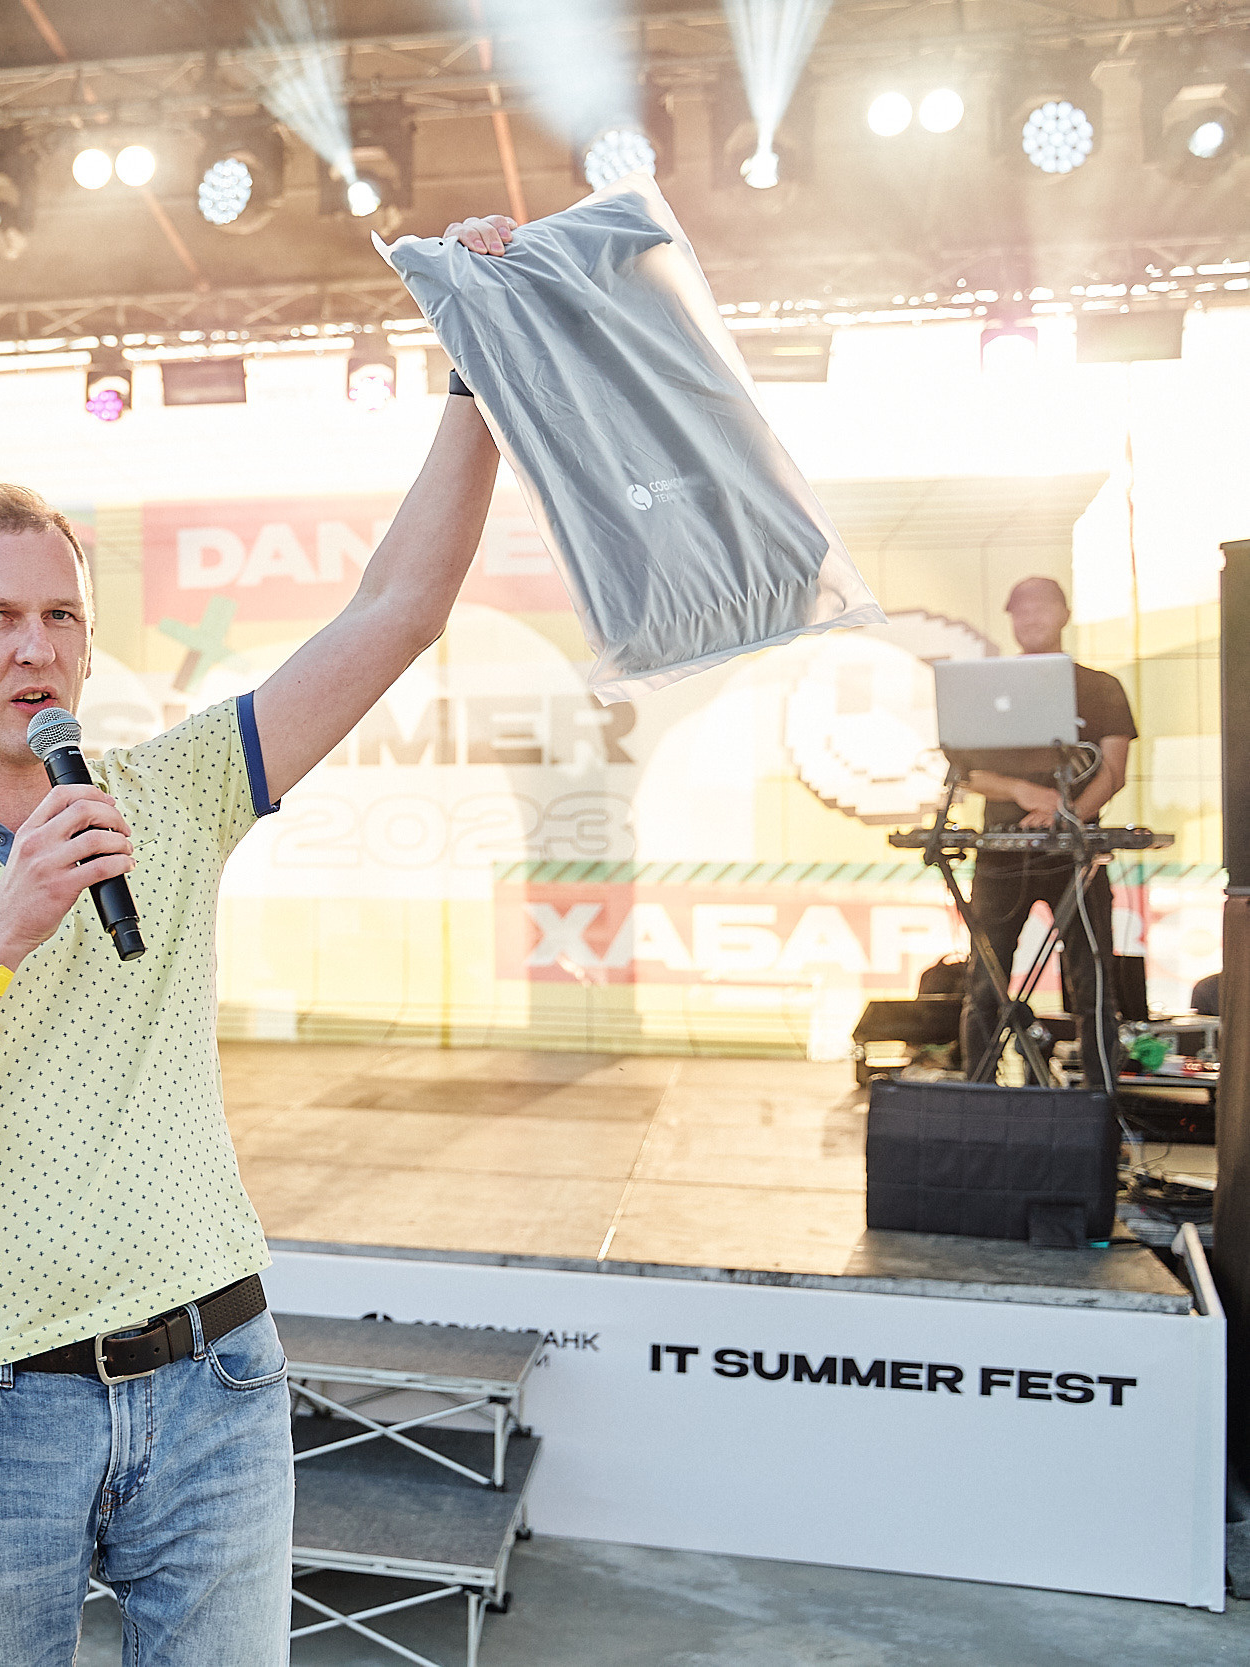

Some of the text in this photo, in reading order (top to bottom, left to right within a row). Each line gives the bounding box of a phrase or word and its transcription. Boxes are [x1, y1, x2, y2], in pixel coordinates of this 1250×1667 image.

[178, 516, 554, 590] DANE
[270, 793, 638, 870] 2023
[650, 1344, 1138, 1407] IT SUMMER FEST
